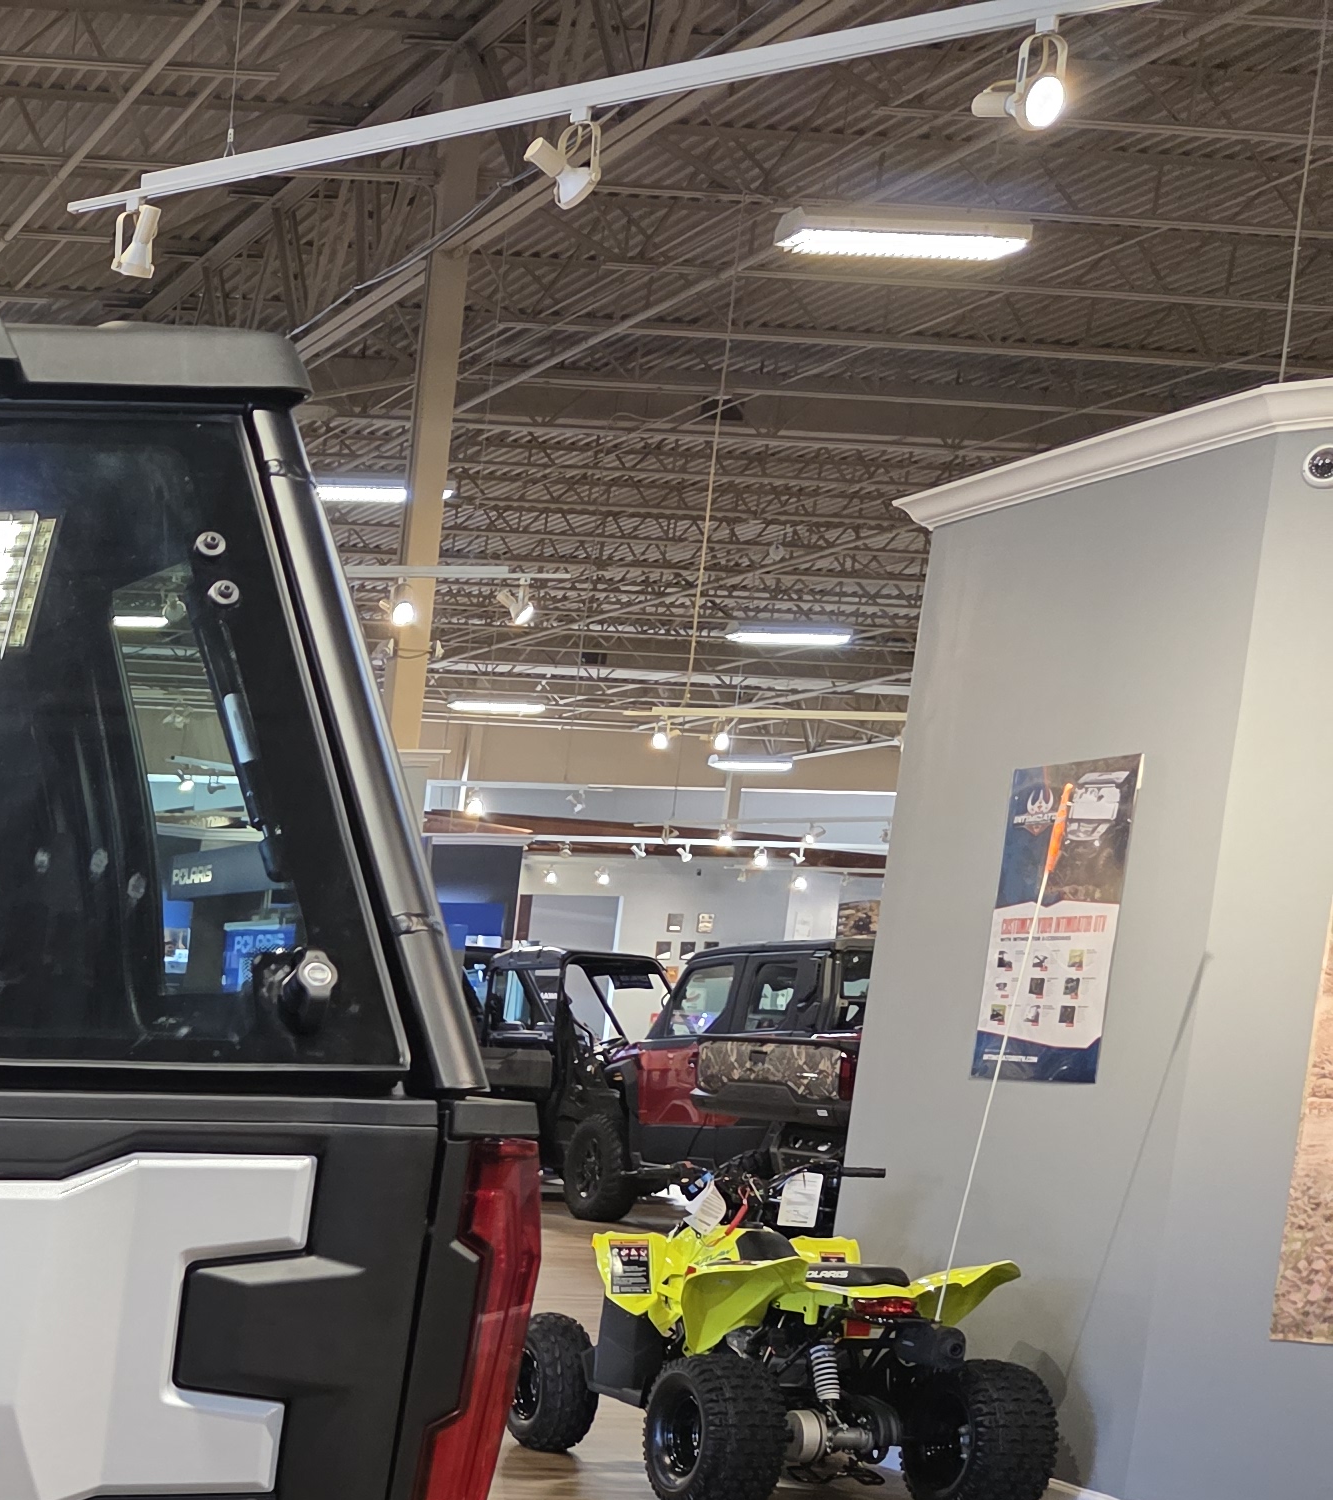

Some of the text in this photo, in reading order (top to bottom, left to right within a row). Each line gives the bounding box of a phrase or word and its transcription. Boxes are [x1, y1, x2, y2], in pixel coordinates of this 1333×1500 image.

[172, 864, 213, 885] POLARIS
[235, 933, 285, 954] POLARIS
[806, 1270, 849, 1279] OLARIS
